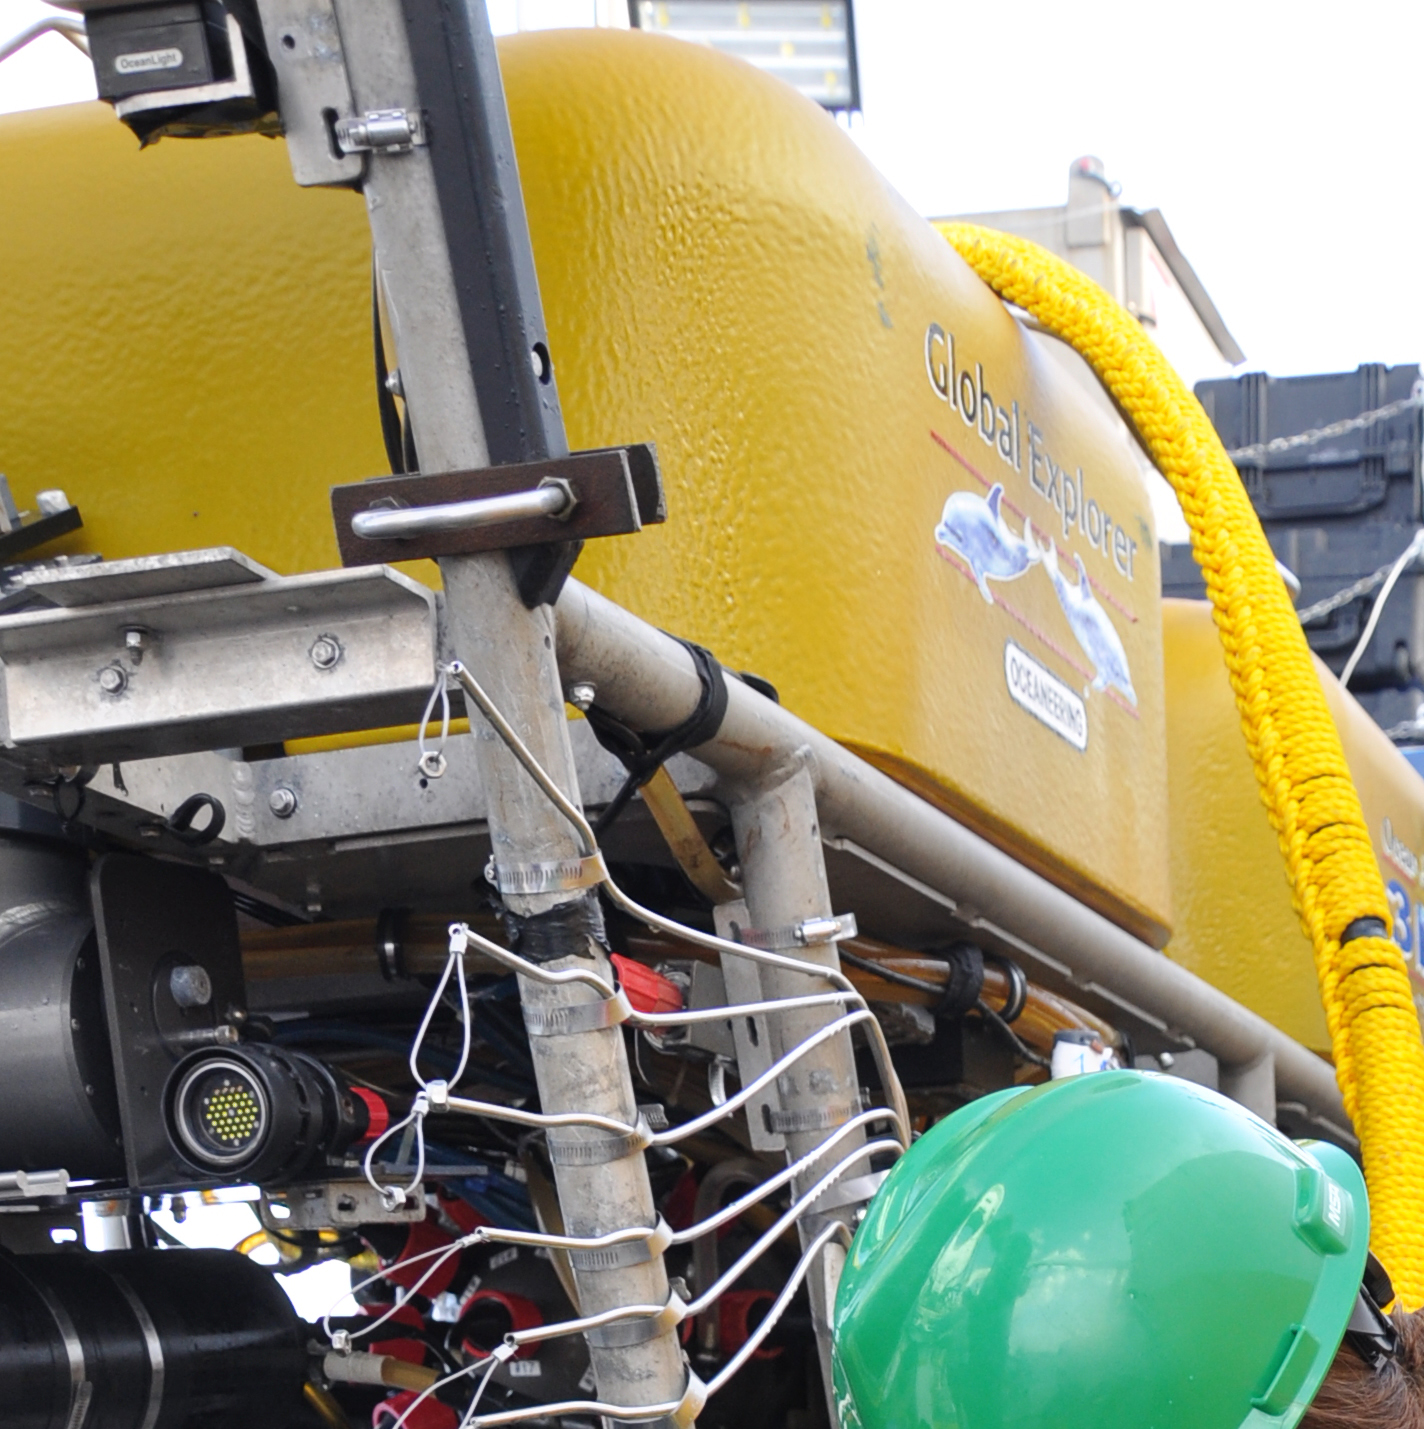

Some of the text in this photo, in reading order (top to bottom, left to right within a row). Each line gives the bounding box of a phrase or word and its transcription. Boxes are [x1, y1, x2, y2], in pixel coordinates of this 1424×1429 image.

[120, 53, 177, 69] OceanLight
[924, 321, 1137, 582] Global Explorer
[1010, 655, 1084, 739] OCEANEERING
